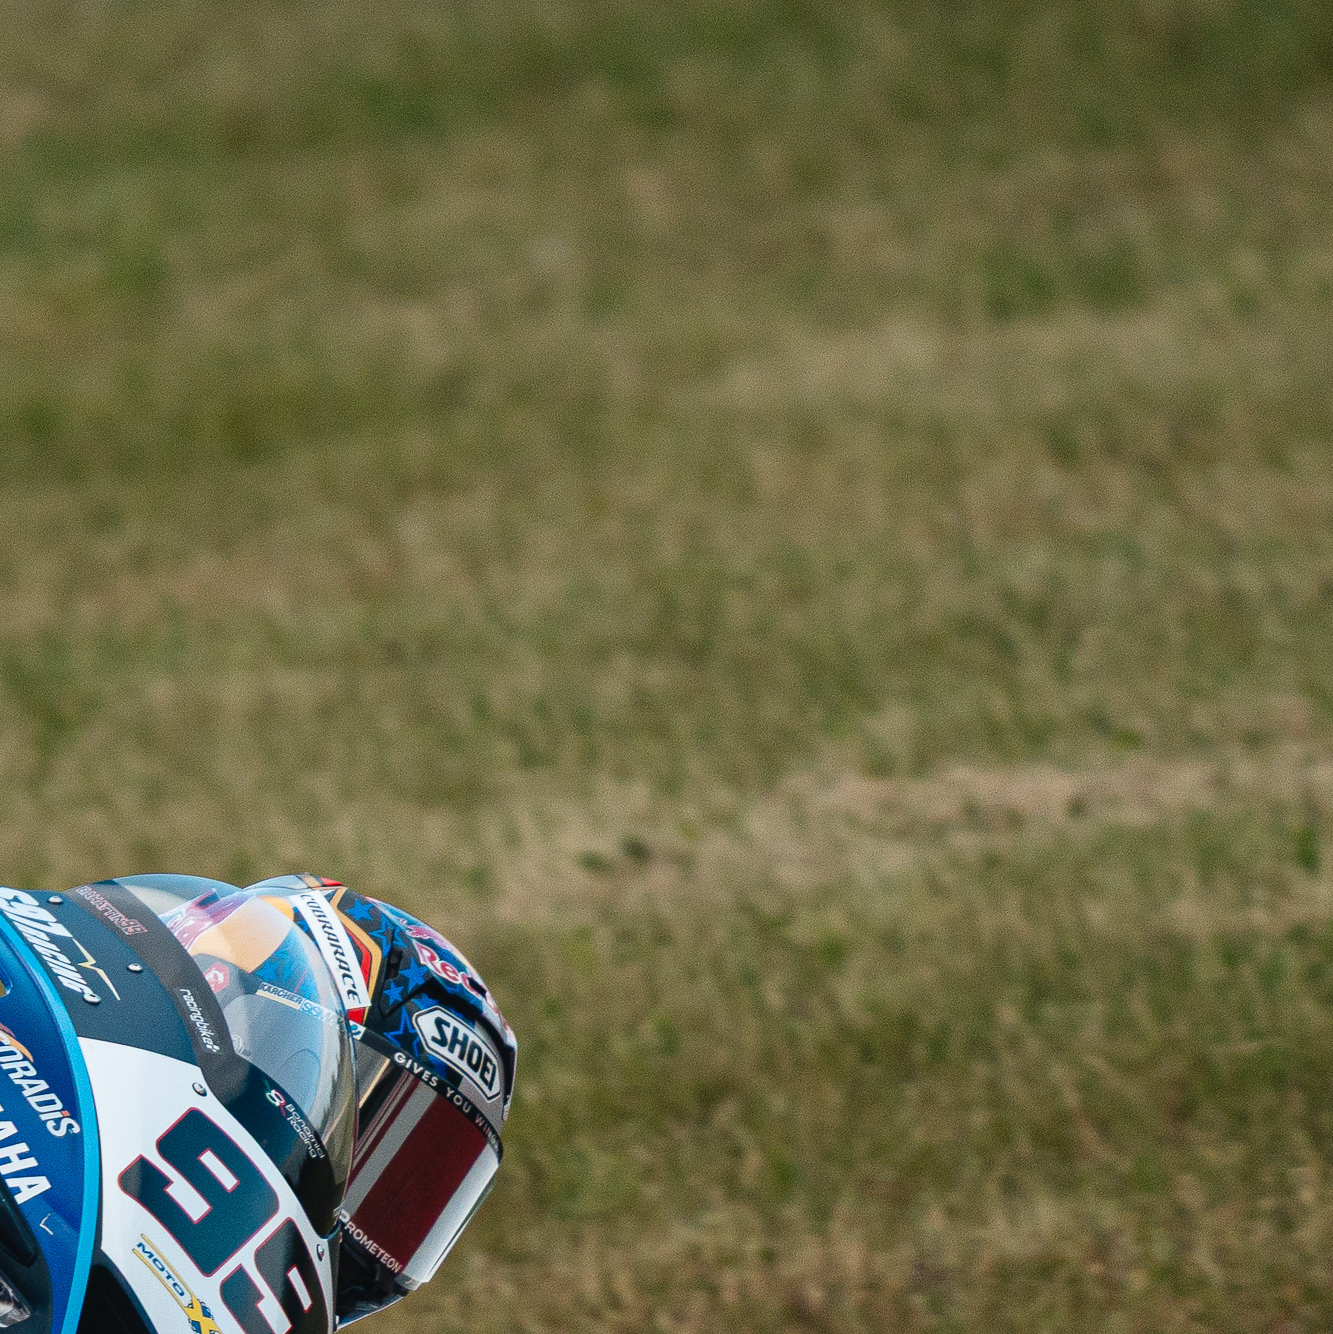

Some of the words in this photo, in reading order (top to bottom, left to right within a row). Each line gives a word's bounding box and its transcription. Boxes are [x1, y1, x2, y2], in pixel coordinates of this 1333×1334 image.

[393, 1051, 438, 1087] GIVES
[446, 1086, 472, 1114] YOU
[430, 1016, 498, 1092] SHOEI
[136, 1241, 185, 1298] MOTO
[338, 1209, 403, 1273] PROMETEON
